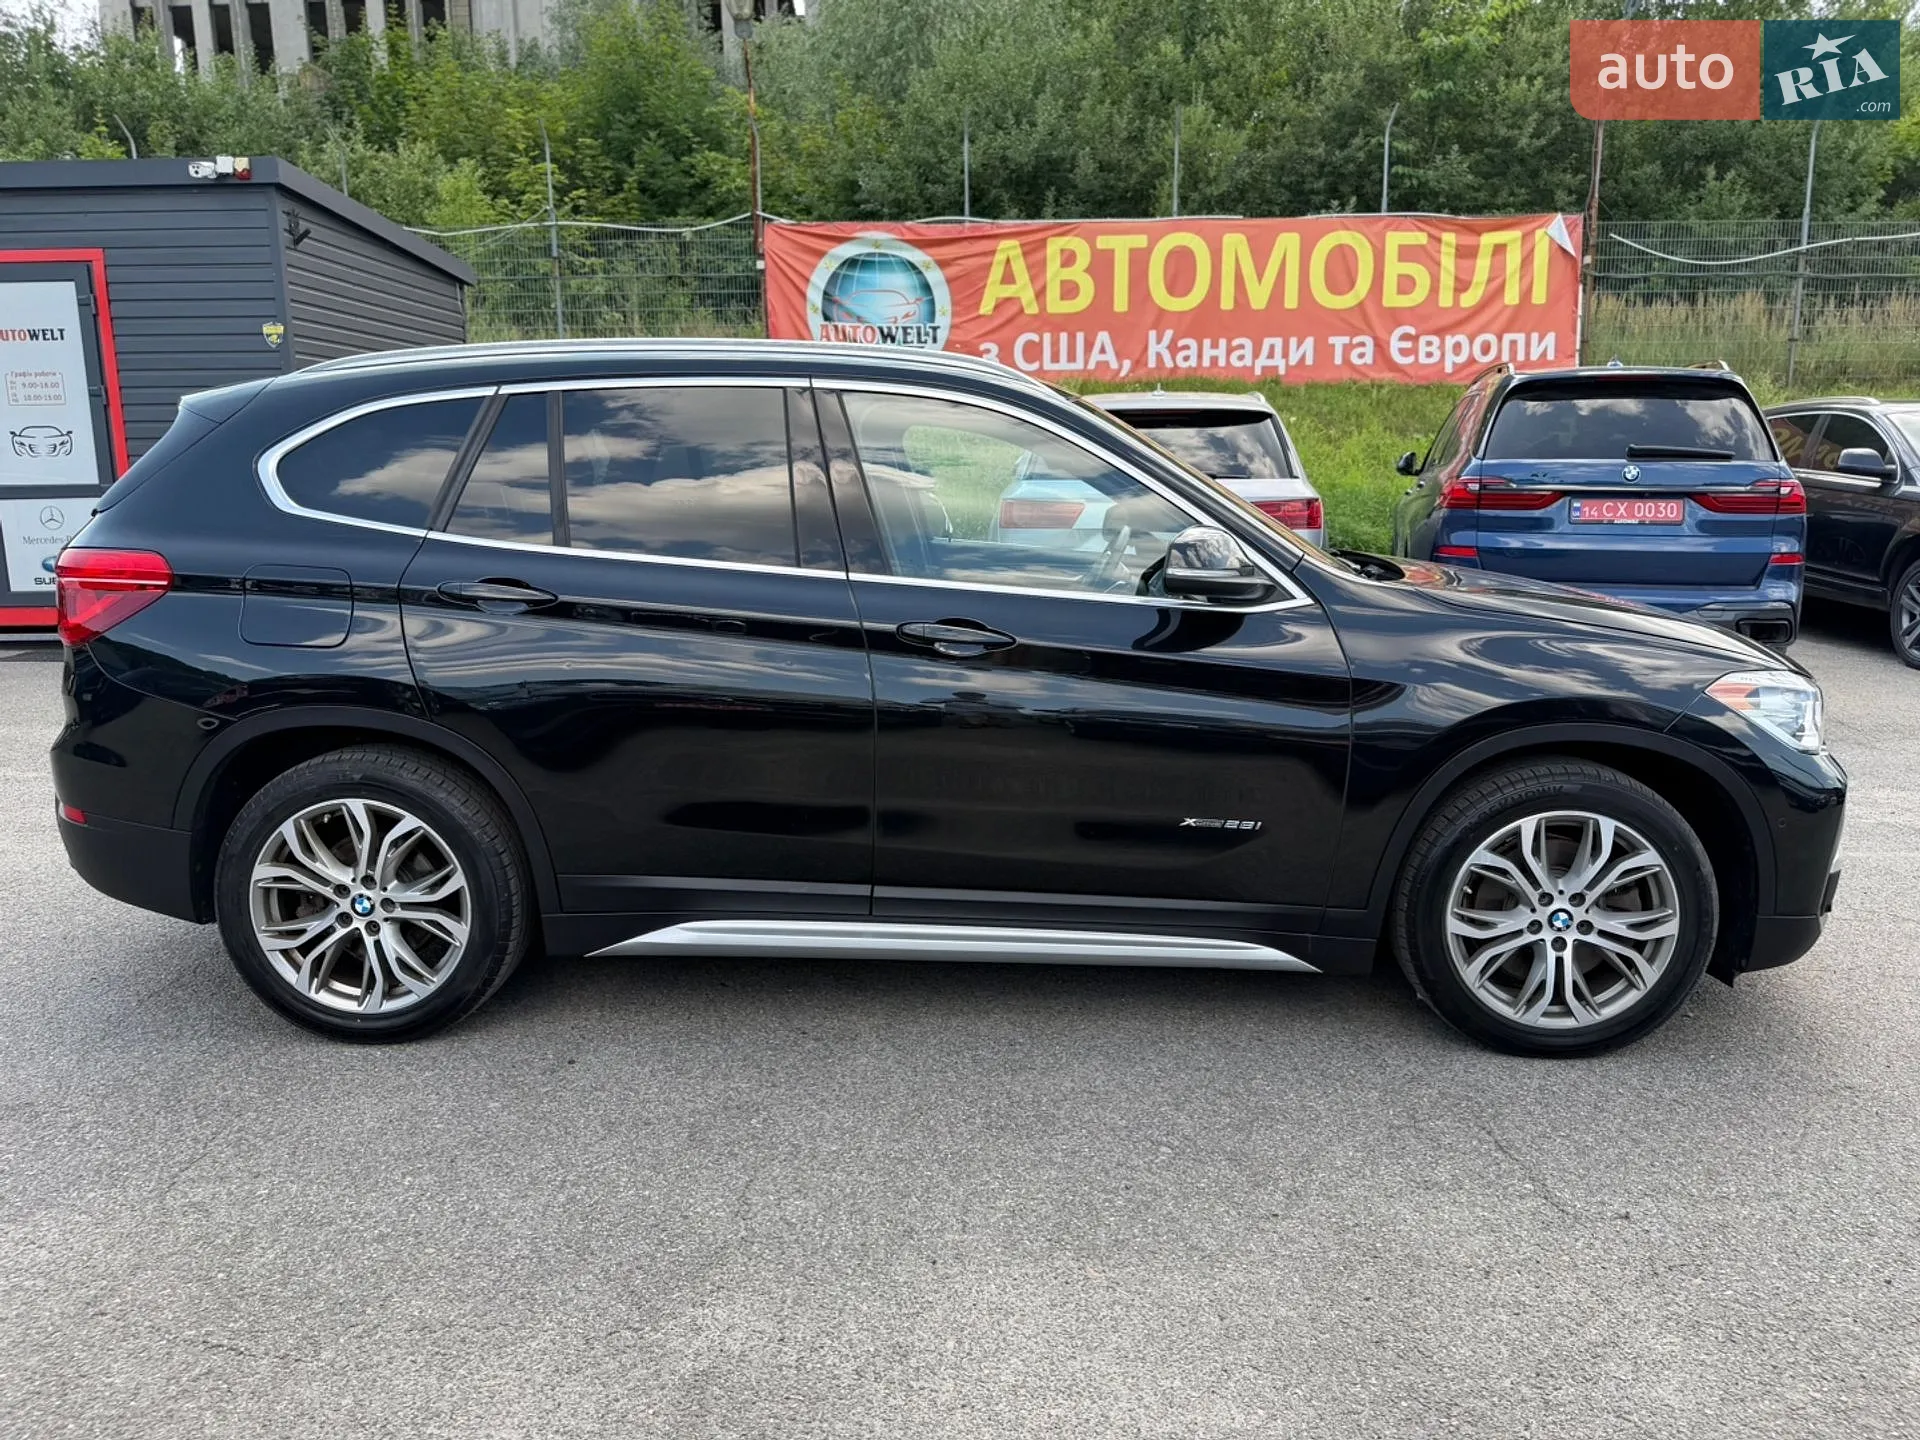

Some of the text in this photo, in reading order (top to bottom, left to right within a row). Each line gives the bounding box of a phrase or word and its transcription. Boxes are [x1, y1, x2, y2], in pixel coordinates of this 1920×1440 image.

[979, 229, 1550, 316] АВТОМОБІЛІ
[819, 323, 941, 344] AUTOWELT
[1013, 330, 1132, 377] США,
[1147, 328, 1315, 376] Канади
[1328, 335, 1374, 366] та
[1389, 325, 1556, 374] Європи
[1583, 506, 1598, 518] 14
[1602, 502, 1627, 517] CX
[1634, 502, 1678, 518] 0030
